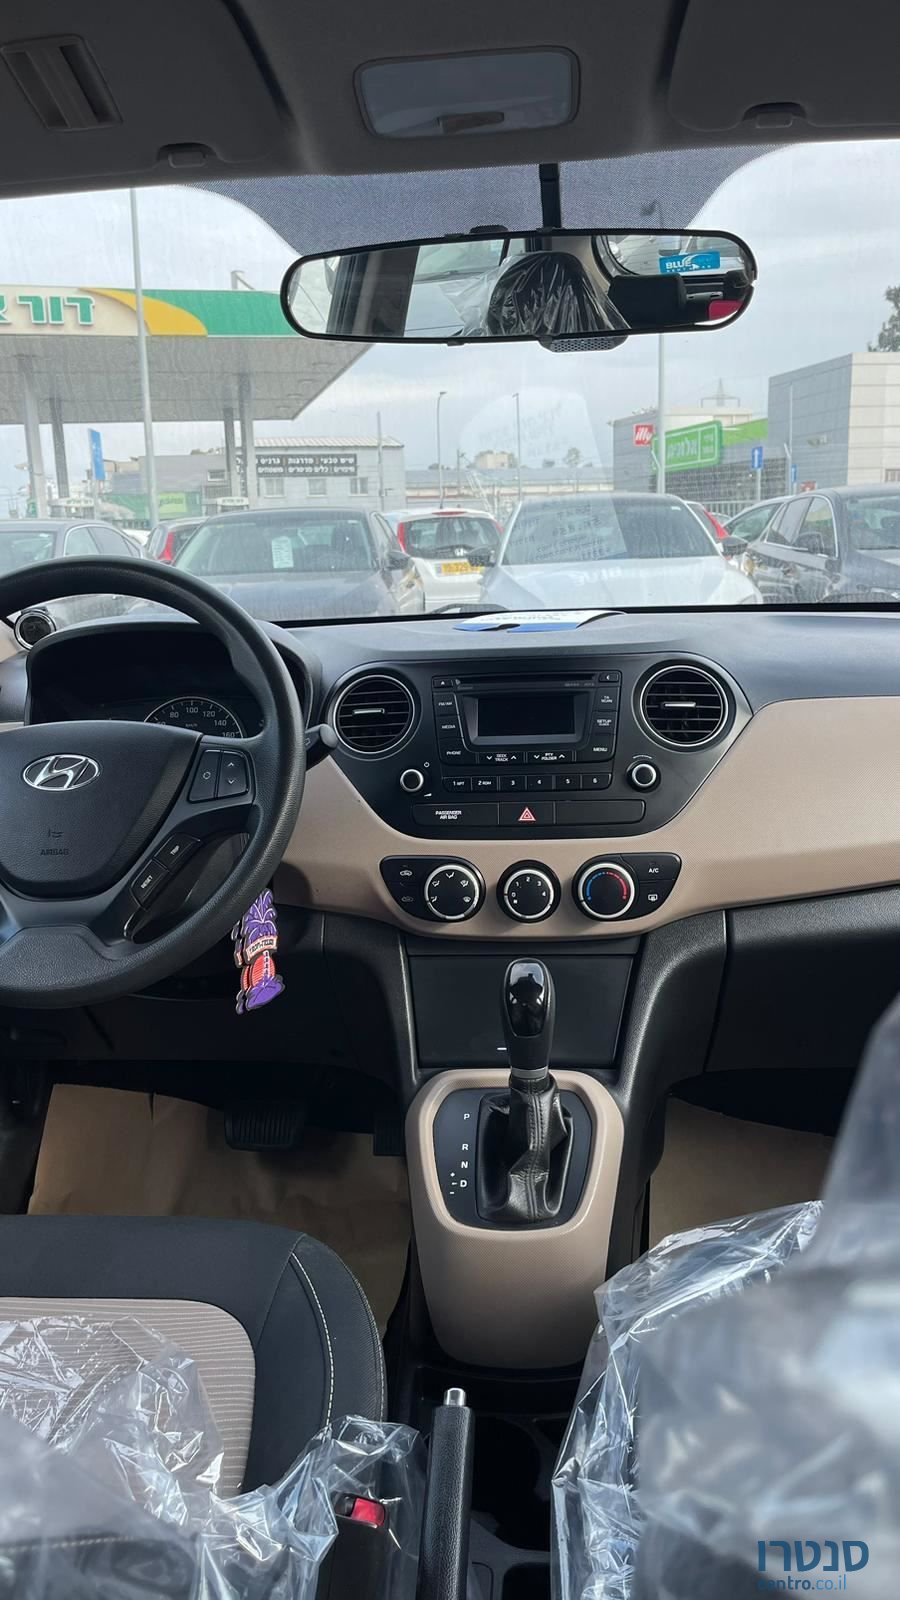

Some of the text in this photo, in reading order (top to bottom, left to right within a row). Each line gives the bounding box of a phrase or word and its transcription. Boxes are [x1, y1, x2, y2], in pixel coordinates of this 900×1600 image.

[17, 295, 95, 325] דור
[635, 427, 653, 444] illy
[185, 706, 199, 714] 100
[202, 710, 216, 718] 120
[214, 719, 227, 727] 140
[460, 1179, 467, 1187] D
